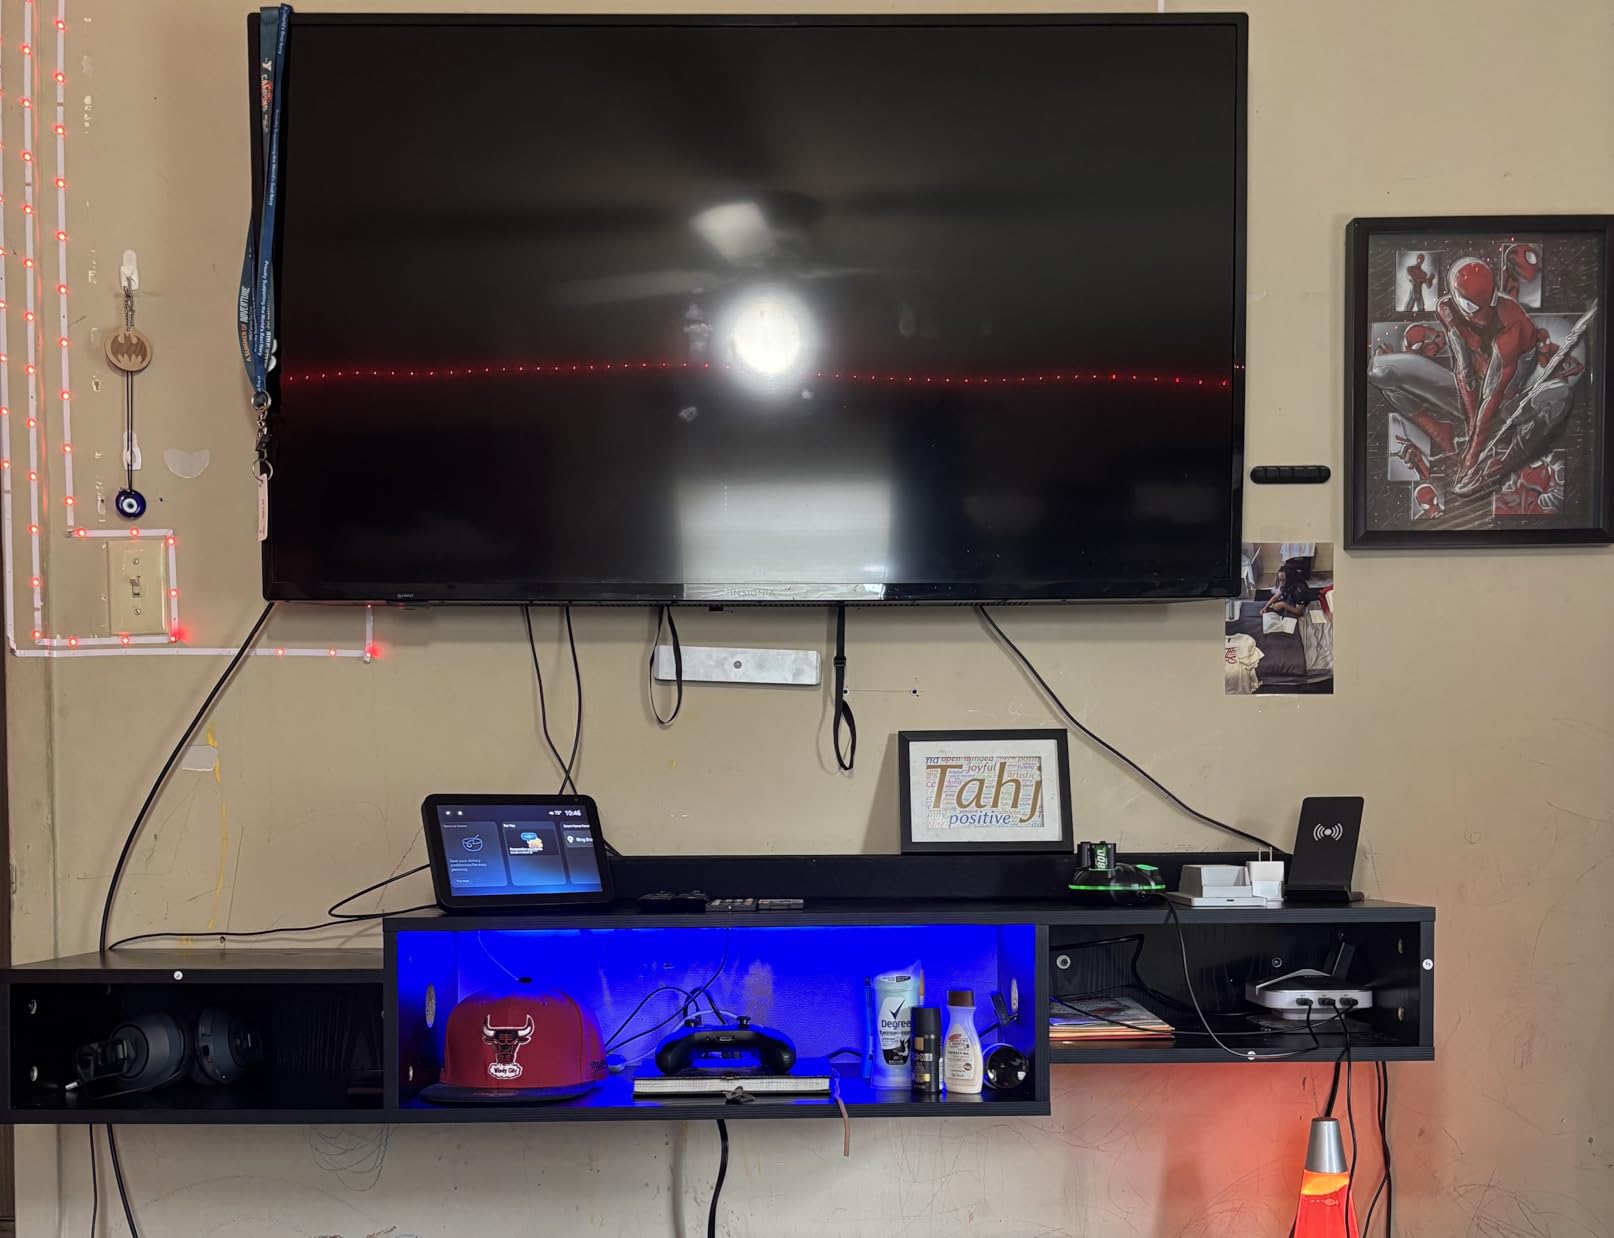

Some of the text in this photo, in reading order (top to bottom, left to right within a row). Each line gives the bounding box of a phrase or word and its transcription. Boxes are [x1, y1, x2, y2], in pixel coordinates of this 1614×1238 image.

[239, 285, 250, 323] ADVENTURE
[241, 331, 250, 357] SUMMER
[966, 762, 997, 774] joyful
[926, 761, 1042, 823] Tahj
[948, 811, 1011, 829] positive
[881, 1019, 912, 1030] Degree
